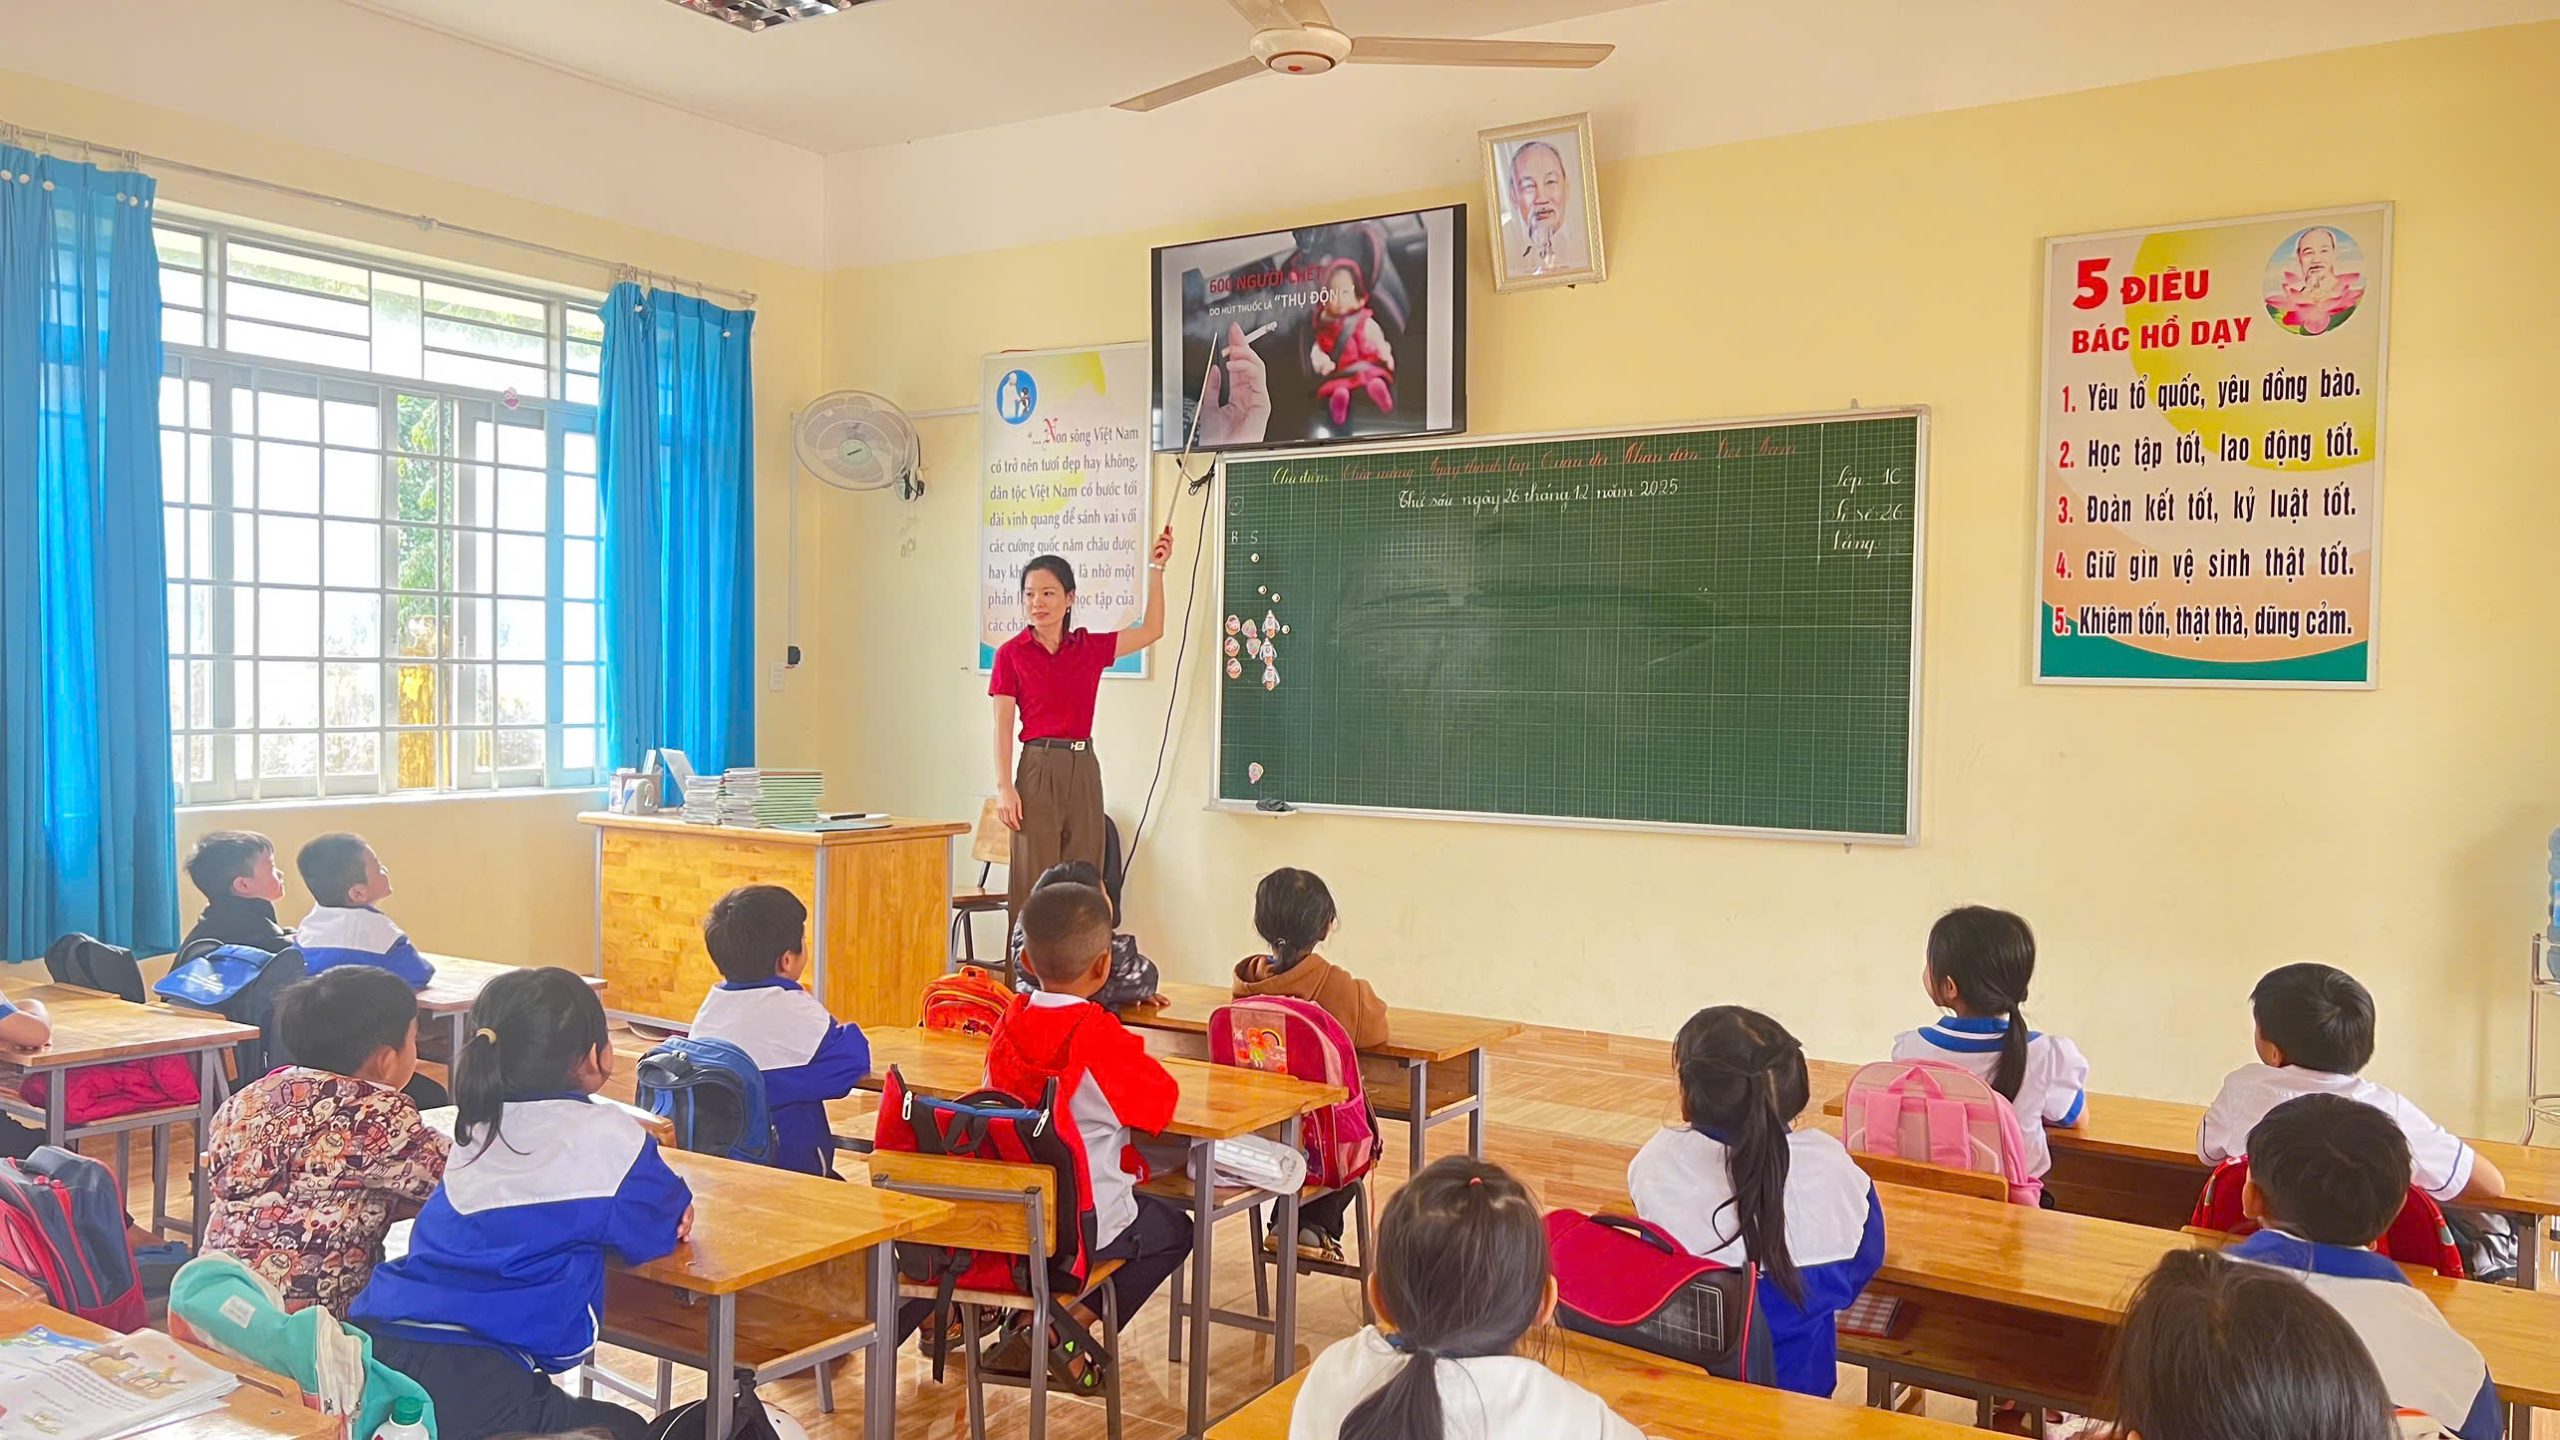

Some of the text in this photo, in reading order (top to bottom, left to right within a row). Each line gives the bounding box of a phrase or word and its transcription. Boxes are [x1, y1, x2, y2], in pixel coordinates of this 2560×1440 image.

[1210, 278, 1232, 293] 600
[2072, 258, 2209, 309] 5 ĐIỀU
[1209, 307, 1220, 316] DO
[1221, 304, 1236, 315] HÚT
[1238, 302, 1262, 312] THUỐC
[2072, 315, 2251, 354] BÁC HỒ DẠY
[2062, 367, 2361, 413] 1. Yêu tổ quốc, yêu đồng bào.
[1070, 428, 1091, 446] sông
[1094, 427, 1112, 445] Việt
[1116, 427, 1138, 440] Nam
[2059, 422, 2358, 472] 2. Học tập tốt, lao động tốt.
[991, 453, 1138, 474] có trở nên tươi đẹp hay không,
[1882, 468, 1901, 485] 1C
[990, 480, 1138, 502] dân tộc Việt Nam có bước tới
[1399, 478, 1678, 518] Thứ sáu ngày 26 tháng 12 năm 2025
[2058, 481, 2356, 523] 3. Đoàn kết tốt, kỷ luật tốt.
[989, 506, 1137, 529] đài vinh quang để sánh vai với
[1880, 503, 1903, 521] 26
[989, 535, 1136, 556] các cường quốc năm châu được
[988, 564, 1007, 582] hay
[1079, 564, 1088, 578] là
[1092, 563, 1112, 578] nhờ
[1115, 564, 1135, 582] một
[2056, 541, 2354, 584] 4. Giữ gìn vệ sinh thật tốt.
[988, 588, 1013, 609] phần
[1096, 592, 1112, 610] tập
[1115, 590, 1134, 606] của
[988, 618, 1005, 632] các
[2054, 601, 2352, 640] 5. Khiêm tốn, thật thà, dũng cảm.
